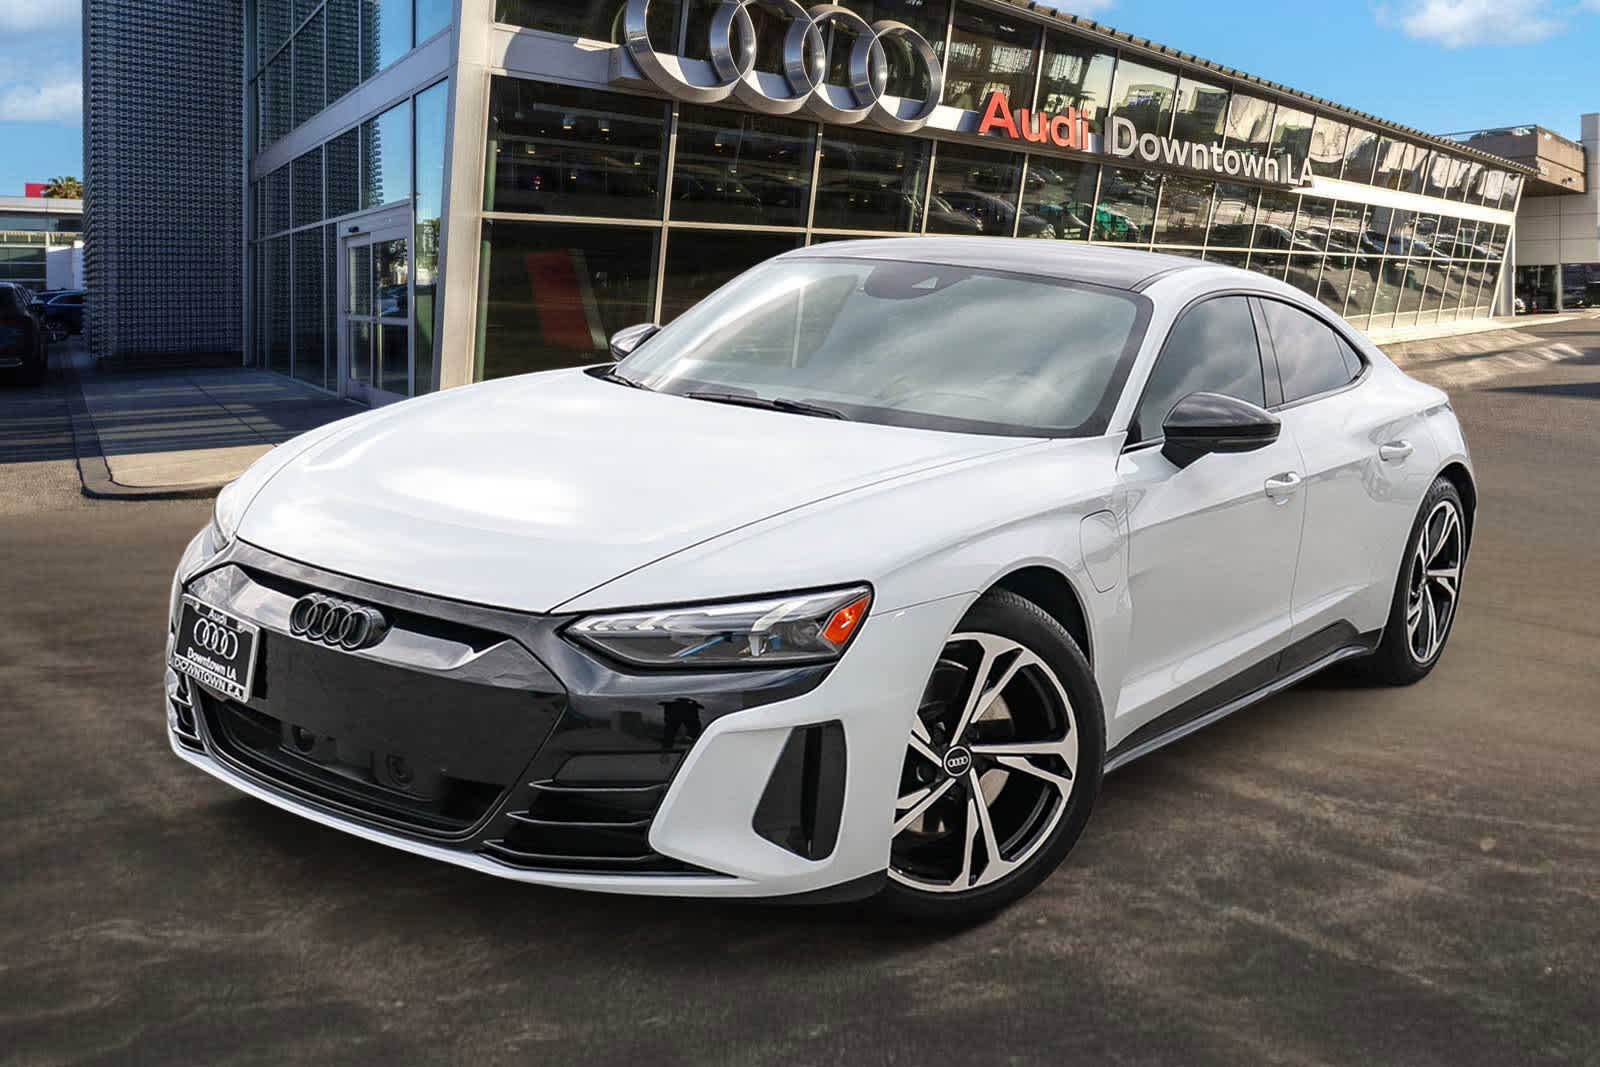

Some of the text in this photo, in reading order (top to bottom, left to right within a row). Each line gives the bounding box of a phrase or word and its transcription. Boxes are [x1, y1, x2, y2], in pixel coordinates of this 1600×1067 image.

[978, 91, 1317, 188] Audi Downtown LA
[187, 647, 236, 680] Downtown LA
